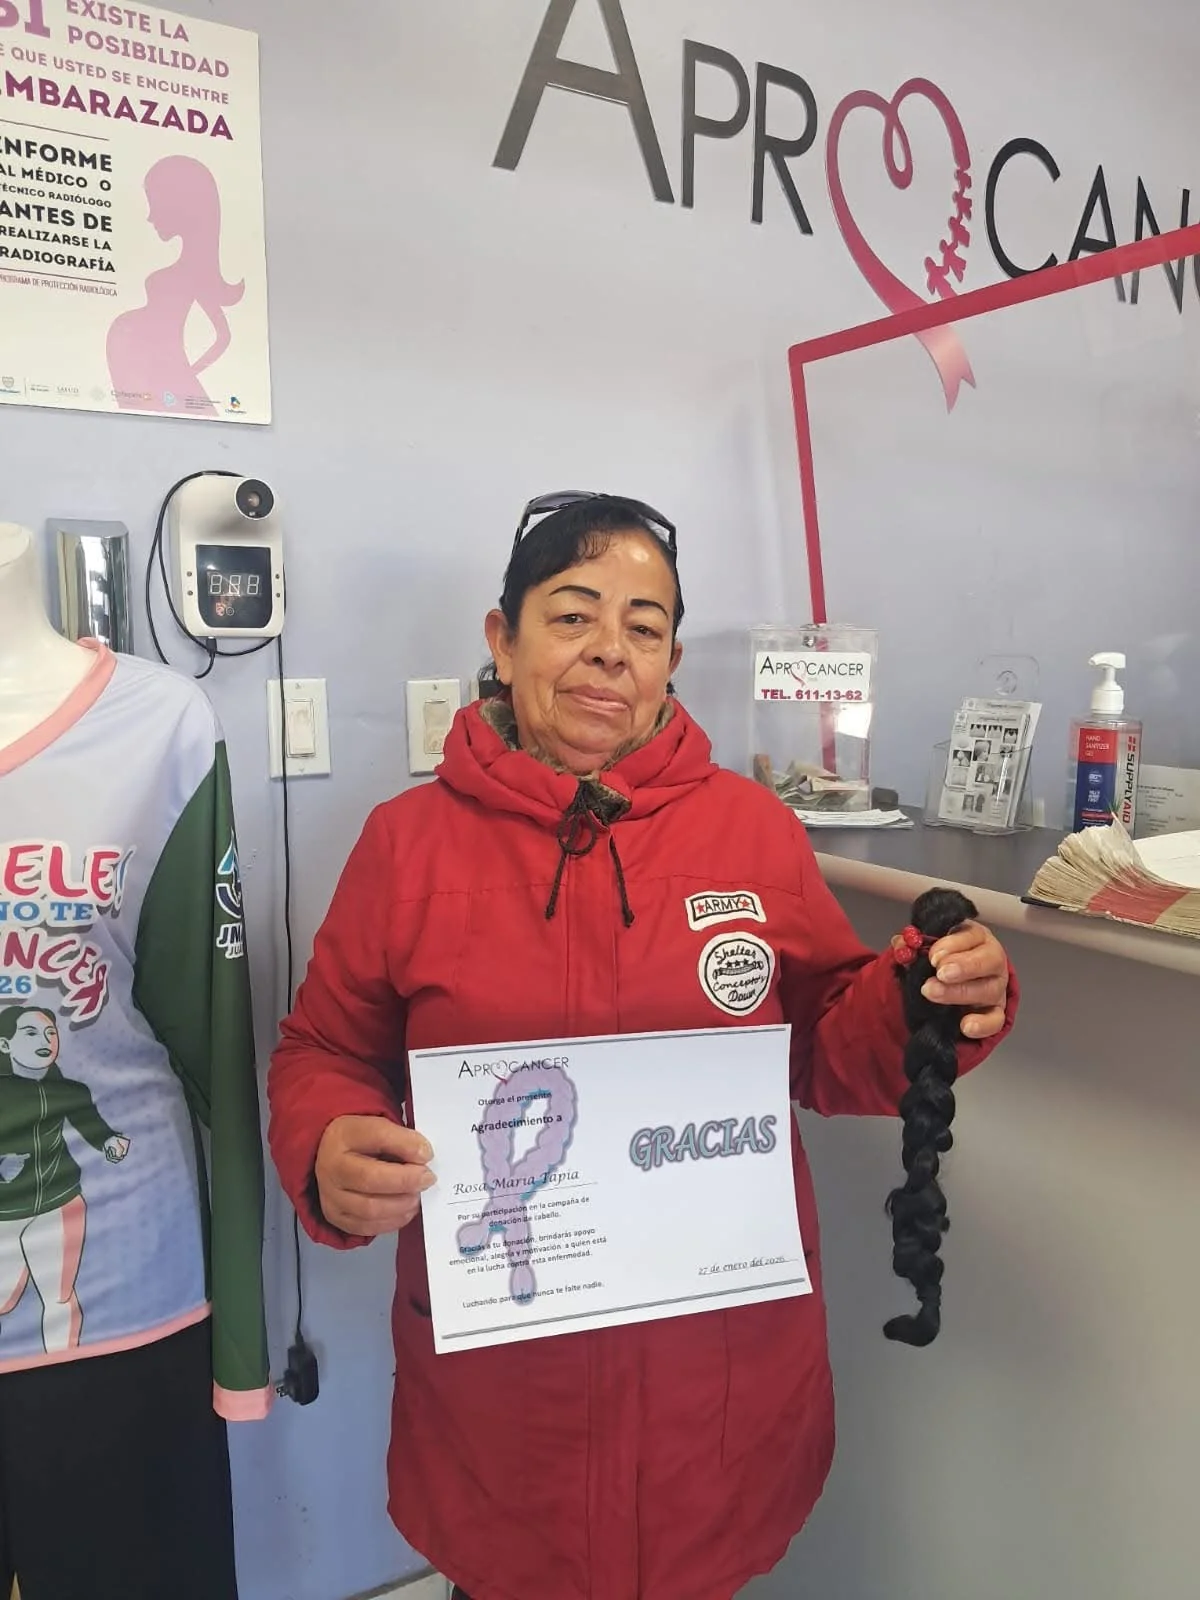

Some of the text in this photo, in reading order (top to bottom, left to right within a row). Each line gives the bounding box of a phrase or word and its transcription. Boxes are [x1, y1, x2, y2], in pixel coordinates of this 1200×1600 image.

[66, 0, 189, 42] EXISTE LA
[67, 25, 230, 78] POSIBILIDAD
[11, 46, 48, 67] QUE
[53, 57, 107, 80] USTED
[112, 69, 132, 85] SE
[137, 75, 229, 105] ENCUENTRE
[0, 70, 234, 141] MBARAZADA
[0, 136, 113, 173] NFORME
[21, 167, 88, 188] MÉDICO
[99, 180, 112, 192] O
[48, 191, 112, 209] RADIÓLOGO
[0, 199, 113, 233] ANTES DE
[0, 225, 112, 251] REALIZARSE LA
[0, 245, 116, 273] RADIOGRAFÍA
[761, 688, 863, 700] TEL. 611-13-62
[50, 901, 94, 921] TE
[704, 897, 741, 913] ARMY
[715, 945, 757, 965] Shelter
[478, 1092, 553, 1106] Otorga el presente
[471, 1115, 563, 1134] Agradecimiento a
[629, 1114, 778, 1172] GRACIAS
[453, 1182, 487, 1196] Rosa
[542, 1170, 580, 1187] Tapia
[457, 1213, 470, 1221] Por
[481, 1204, 528, 1219] participación
[547, 1197, 580, 1208] campaña
[488, 1216, 522, 1227] donación
[524, 1214, 532, 1222] de
[522, 1243, 562, 1255] motivación
[570, 1238, 591, 1249] quien
[592, 1236, 607, 1245] está
[538, 1229, 572, 1242] brindarás
[574, 1228, 596, 1238] apoyo
[467, 1267, 477, 1275] en
[485, 1262, 505, 1272] lucha
[506, 1259, 530, 1268] contra
[531, 1255, 546, 1264] esta
[710, 1263, 721, 1274] de
[722, 1260, 748, 1272] enero
[749, 1256, 764, 1268] del
[462, 1296, 498, 1309] Luchando
[499, 1294, 515, 1304] para
[516, 1291, 532, 1302] que
[532, 1288, 555, 1298] nunca
[555, 1286, 564, 1294] te
[564, 1283, 582, 1293] falte
